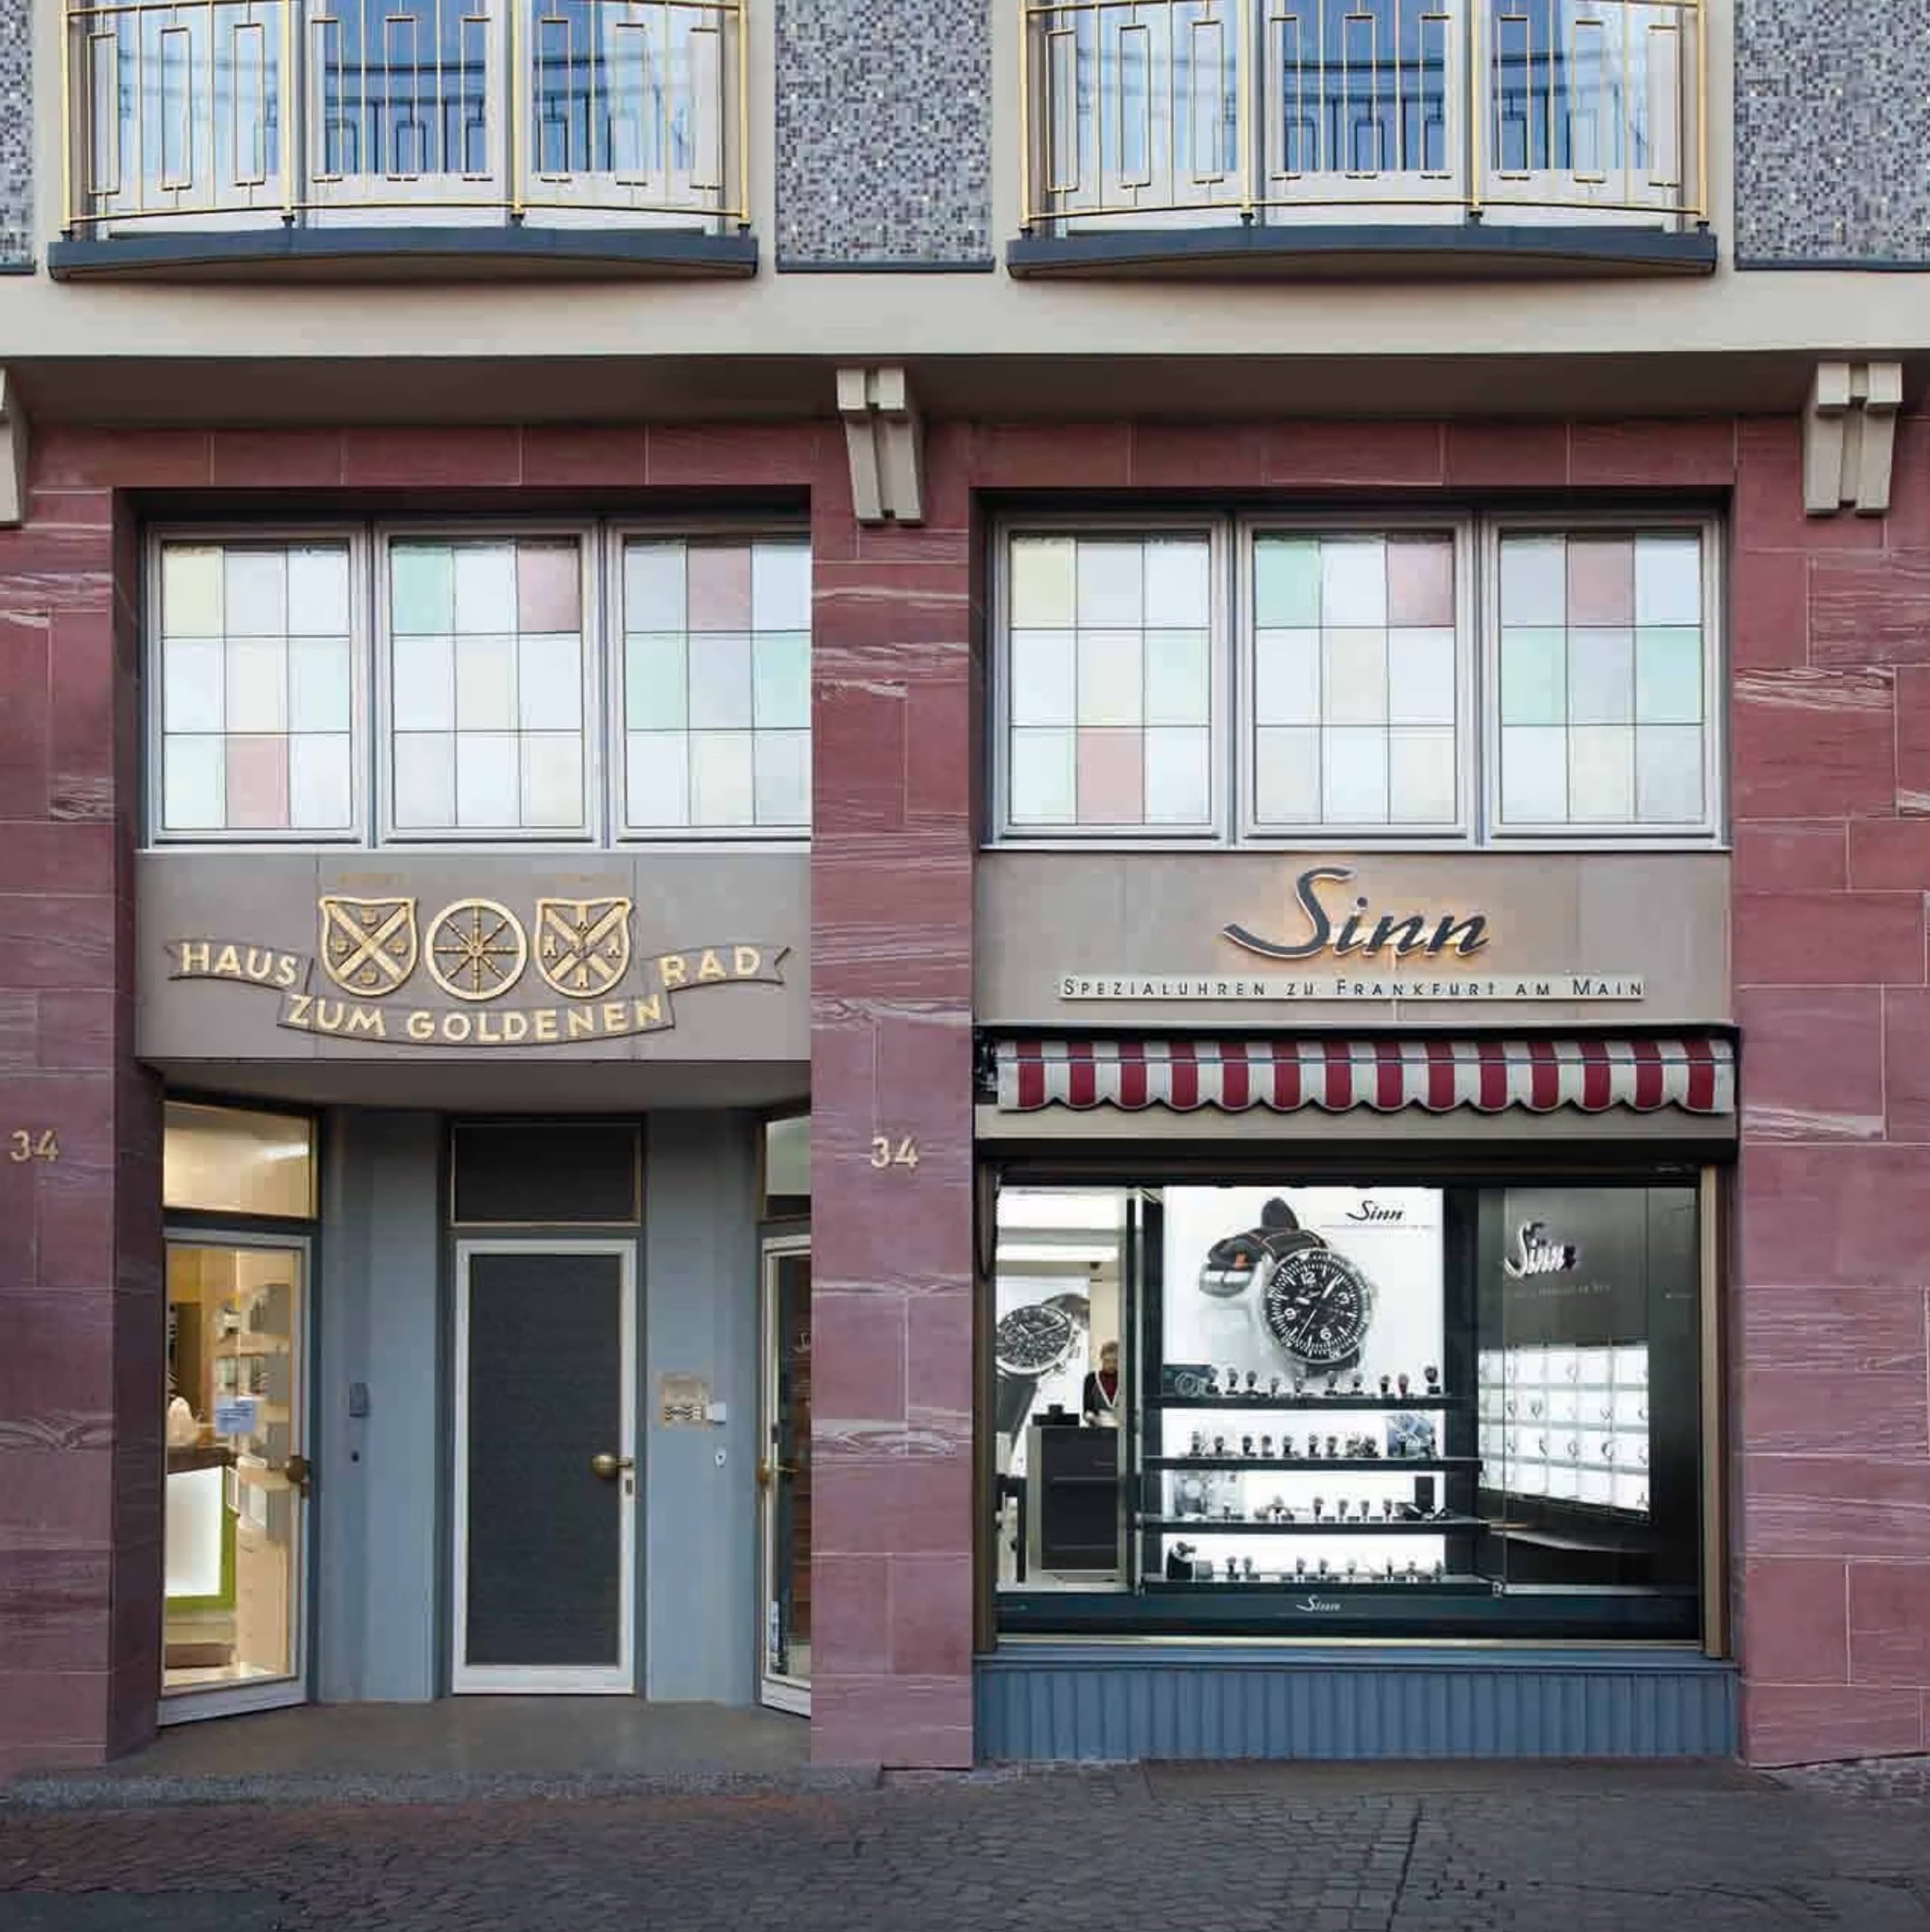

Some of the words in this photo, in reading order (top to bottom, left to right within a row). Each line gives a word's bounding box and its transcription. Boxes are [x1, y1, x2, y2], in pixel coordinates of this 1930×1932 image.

[1224, 867, 1490, 958] Sinn
[181, 942, 298, 985] HAUS
[288, 994, 387, 1037] ZUM
[408, 994, 661, 1041] GOLDENEN
[659, 945, 761, 987] RAD
[1064, 978, 1265, 996] SPEZIALUHREN
[10, 1130, 59, 1162] 34
[871, 1136, 919, 1169] 34
[1345, 1200, 1404, 1221] Sinn
